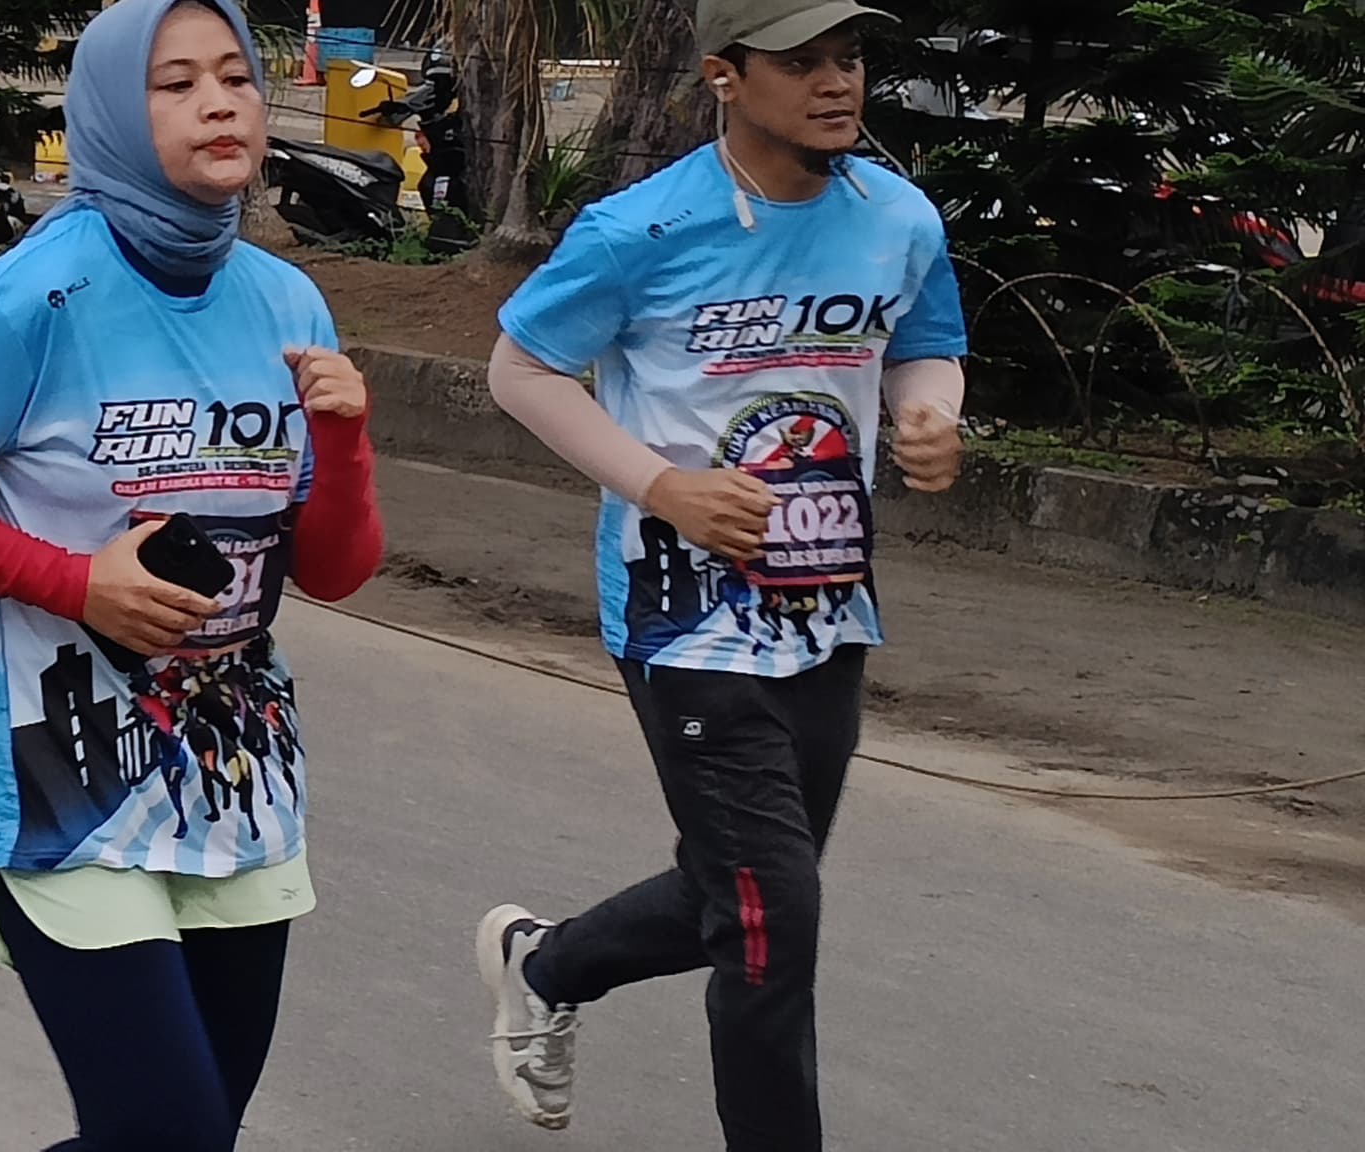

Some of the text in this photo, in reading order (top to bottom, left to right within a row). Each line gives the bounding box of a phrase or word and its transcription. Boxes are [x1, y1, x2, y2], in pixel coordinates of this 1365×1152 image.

[693, 294, 902, 335] FUN 10K
[686, 322, 784, 353] RUN
[96, 399, 195, 433] FUN
[88, 431, 195, 465] RUN
[763, 494, 864, 544] 1022
